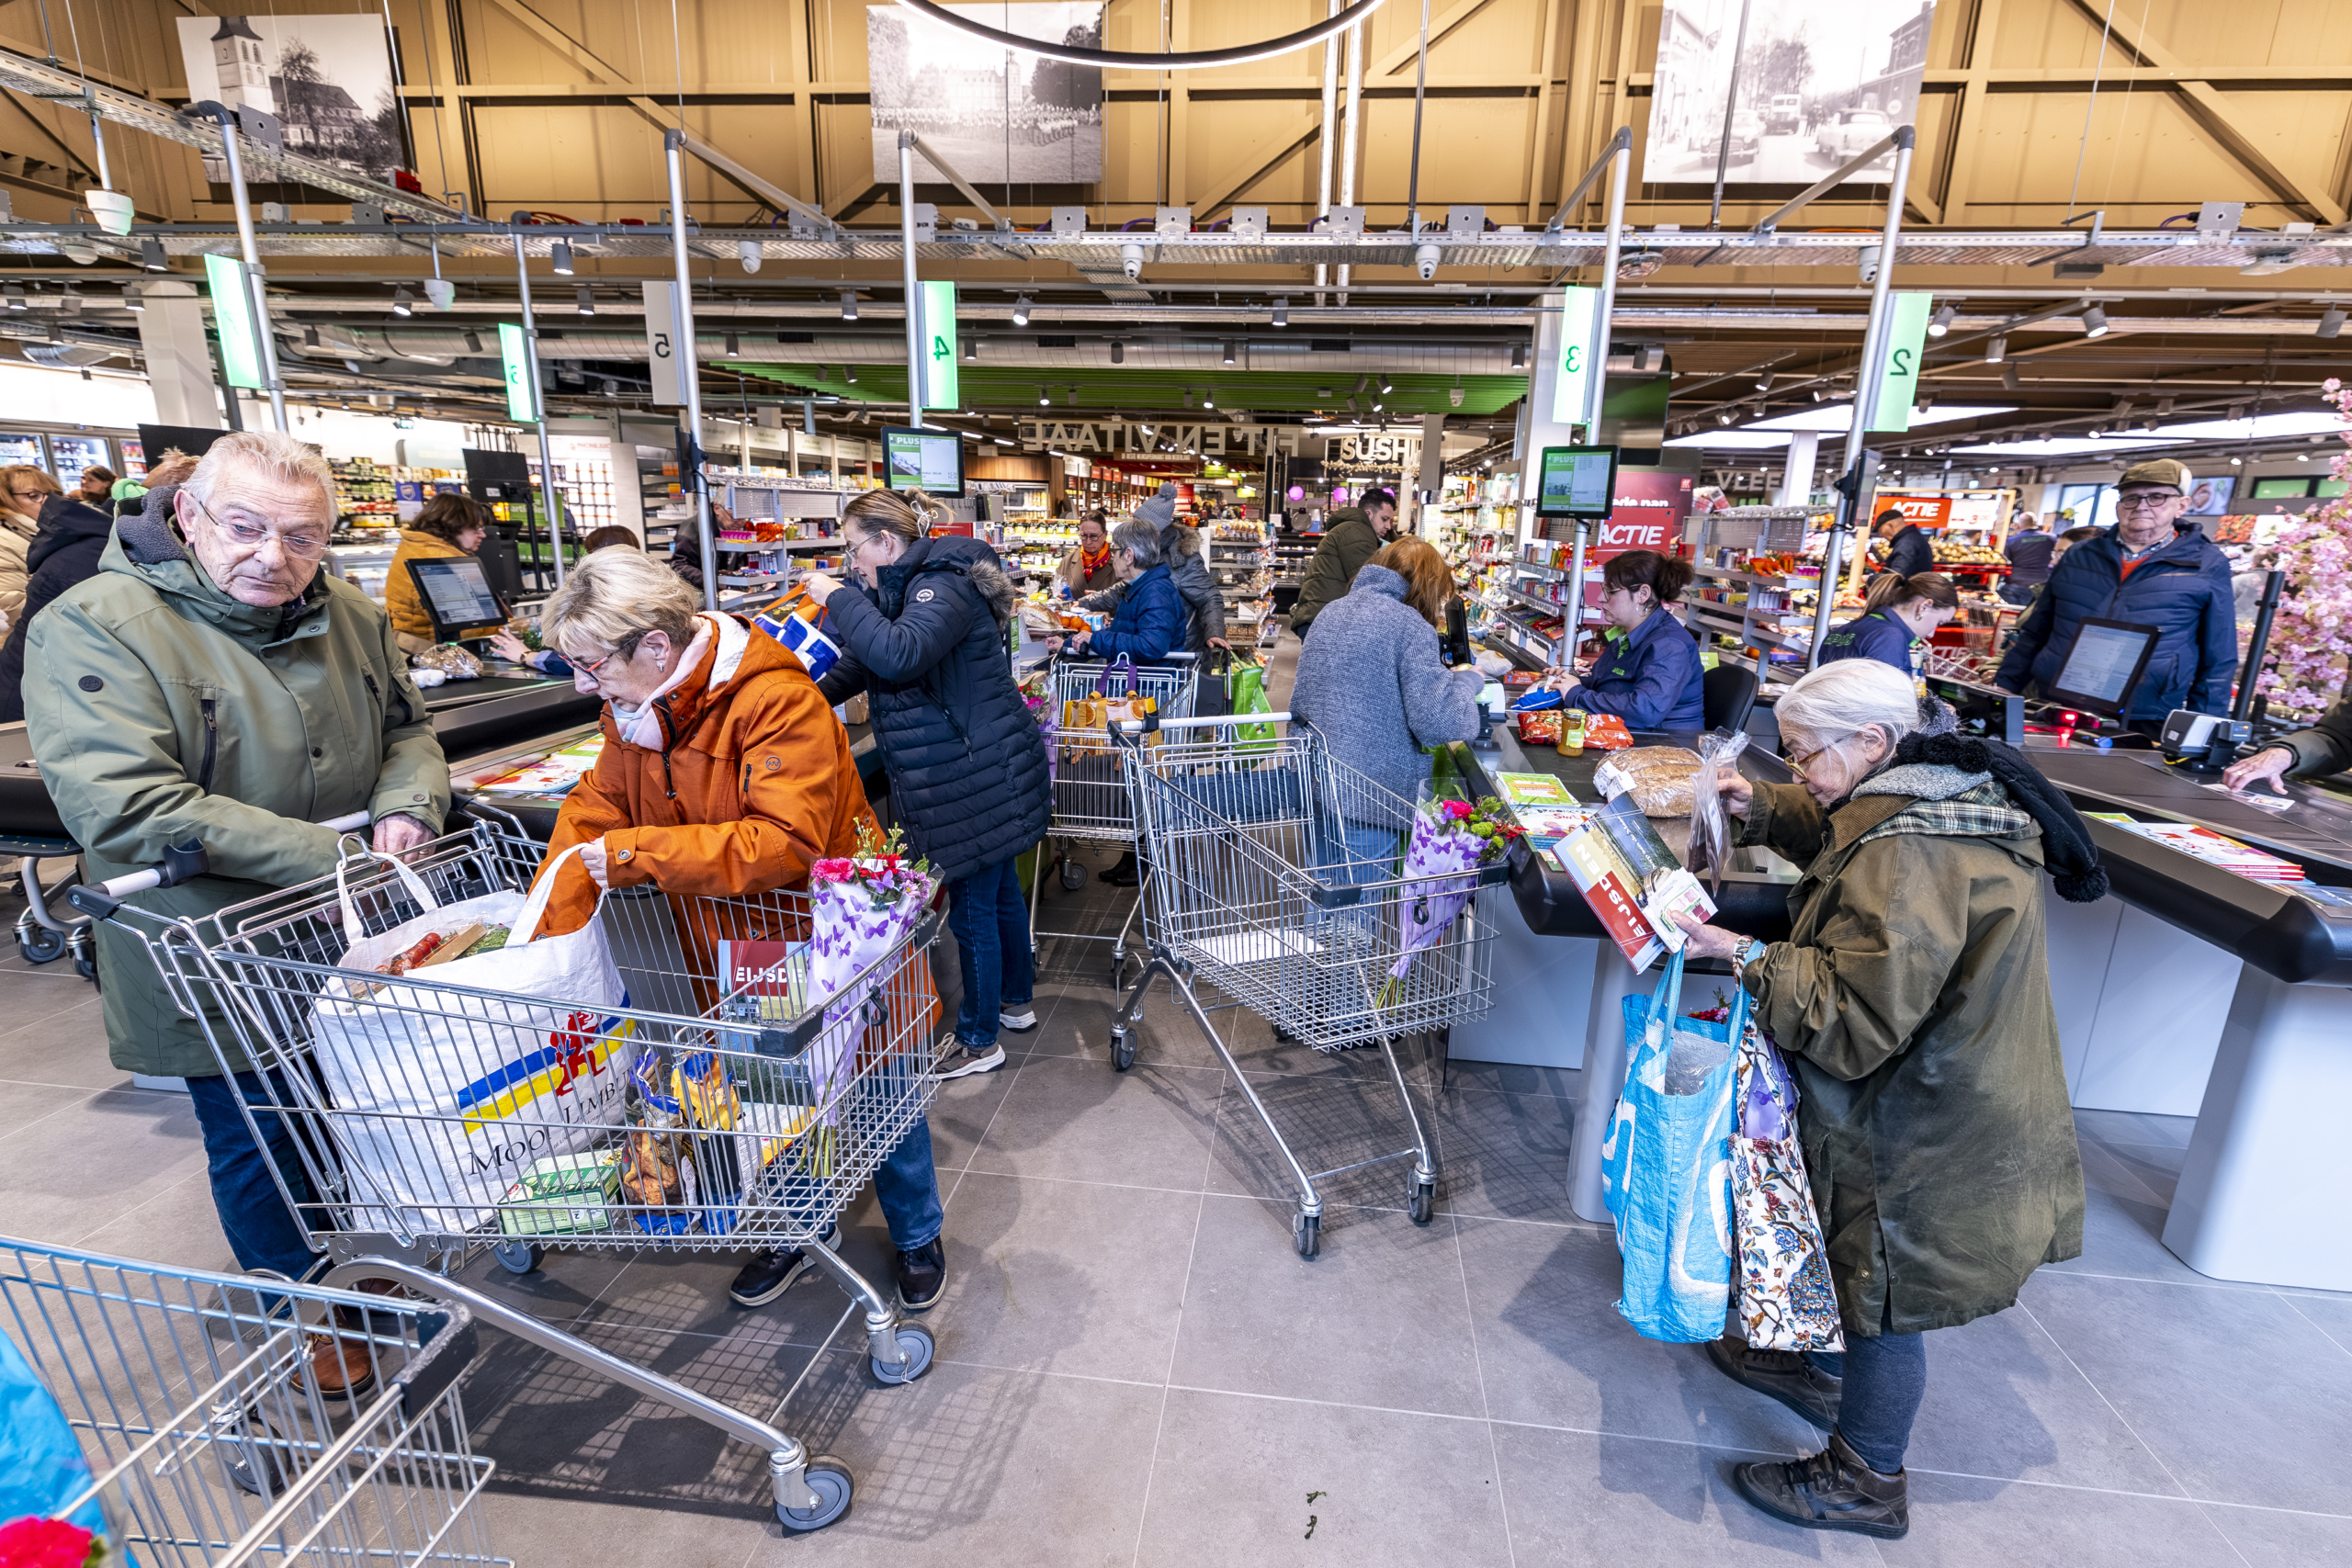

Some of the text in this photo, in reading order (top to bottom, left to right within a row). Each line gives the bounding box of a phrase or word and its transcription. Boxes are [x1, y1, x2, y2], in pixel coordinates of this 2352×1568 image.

[896, 436, 920, 446] PLUS
[1341, 436, 1417, 461] SUSHI
[1554, 456, 1575, 464] PLUS
[1716, 470, 1785, 491] VLEE
[1891, 501, 1941, 517] ACTIE
[1601, 524, 1666, 546] ACTIE
[1575, 842, 1648, 938] EIJSDEN
[735, 966, 808, 984] EIJSDE
